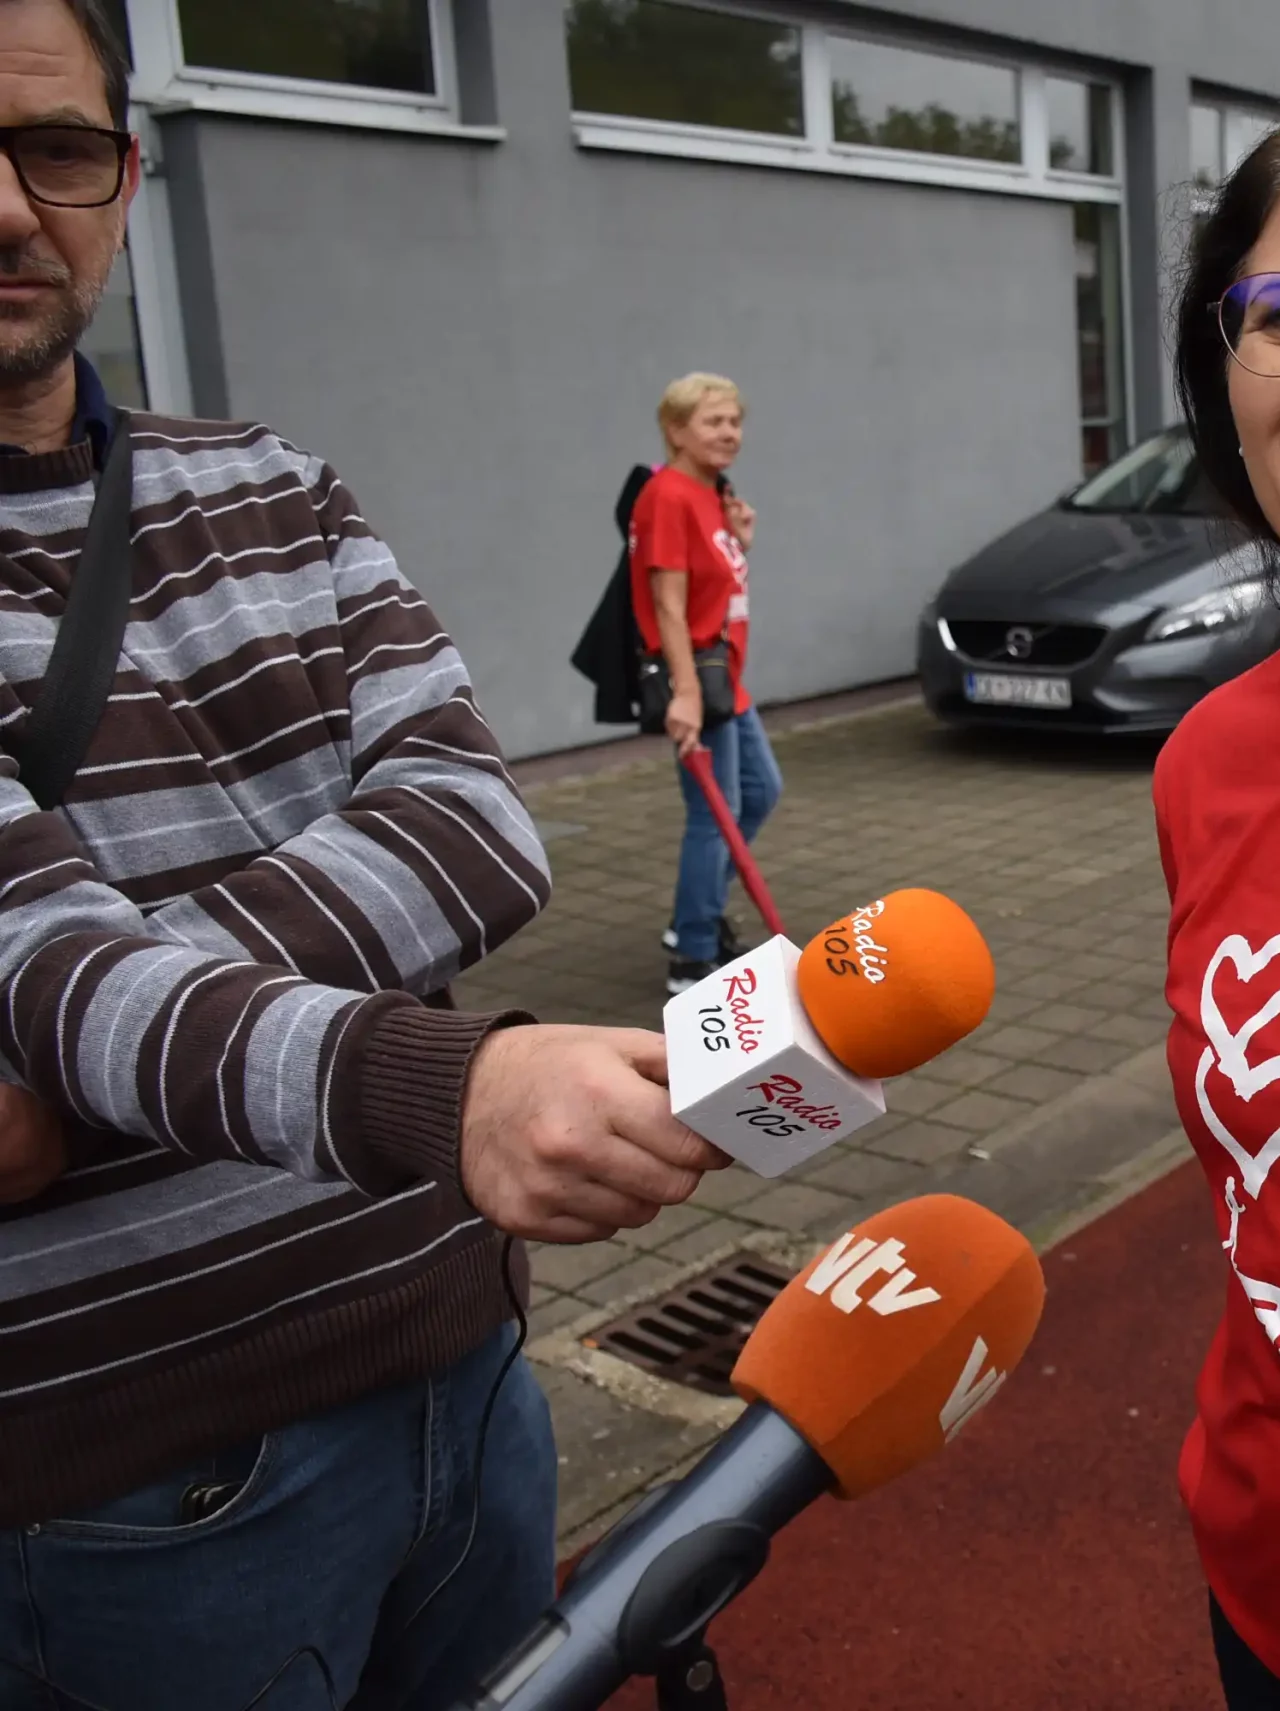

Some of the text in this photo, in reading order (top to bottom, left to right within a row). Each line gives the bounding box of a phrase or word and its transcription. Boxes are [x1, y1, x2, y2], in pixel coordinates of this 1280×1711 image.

[823, 926, 859, 977] 105
[850, 900, 889, 984] Radio
[698, 1004, 730, 1052] 105
[722, 968, 765, 1054] Radio
[735, 1104, 804, 1137] 105
[746, 1073, 843, 1131] Radio
